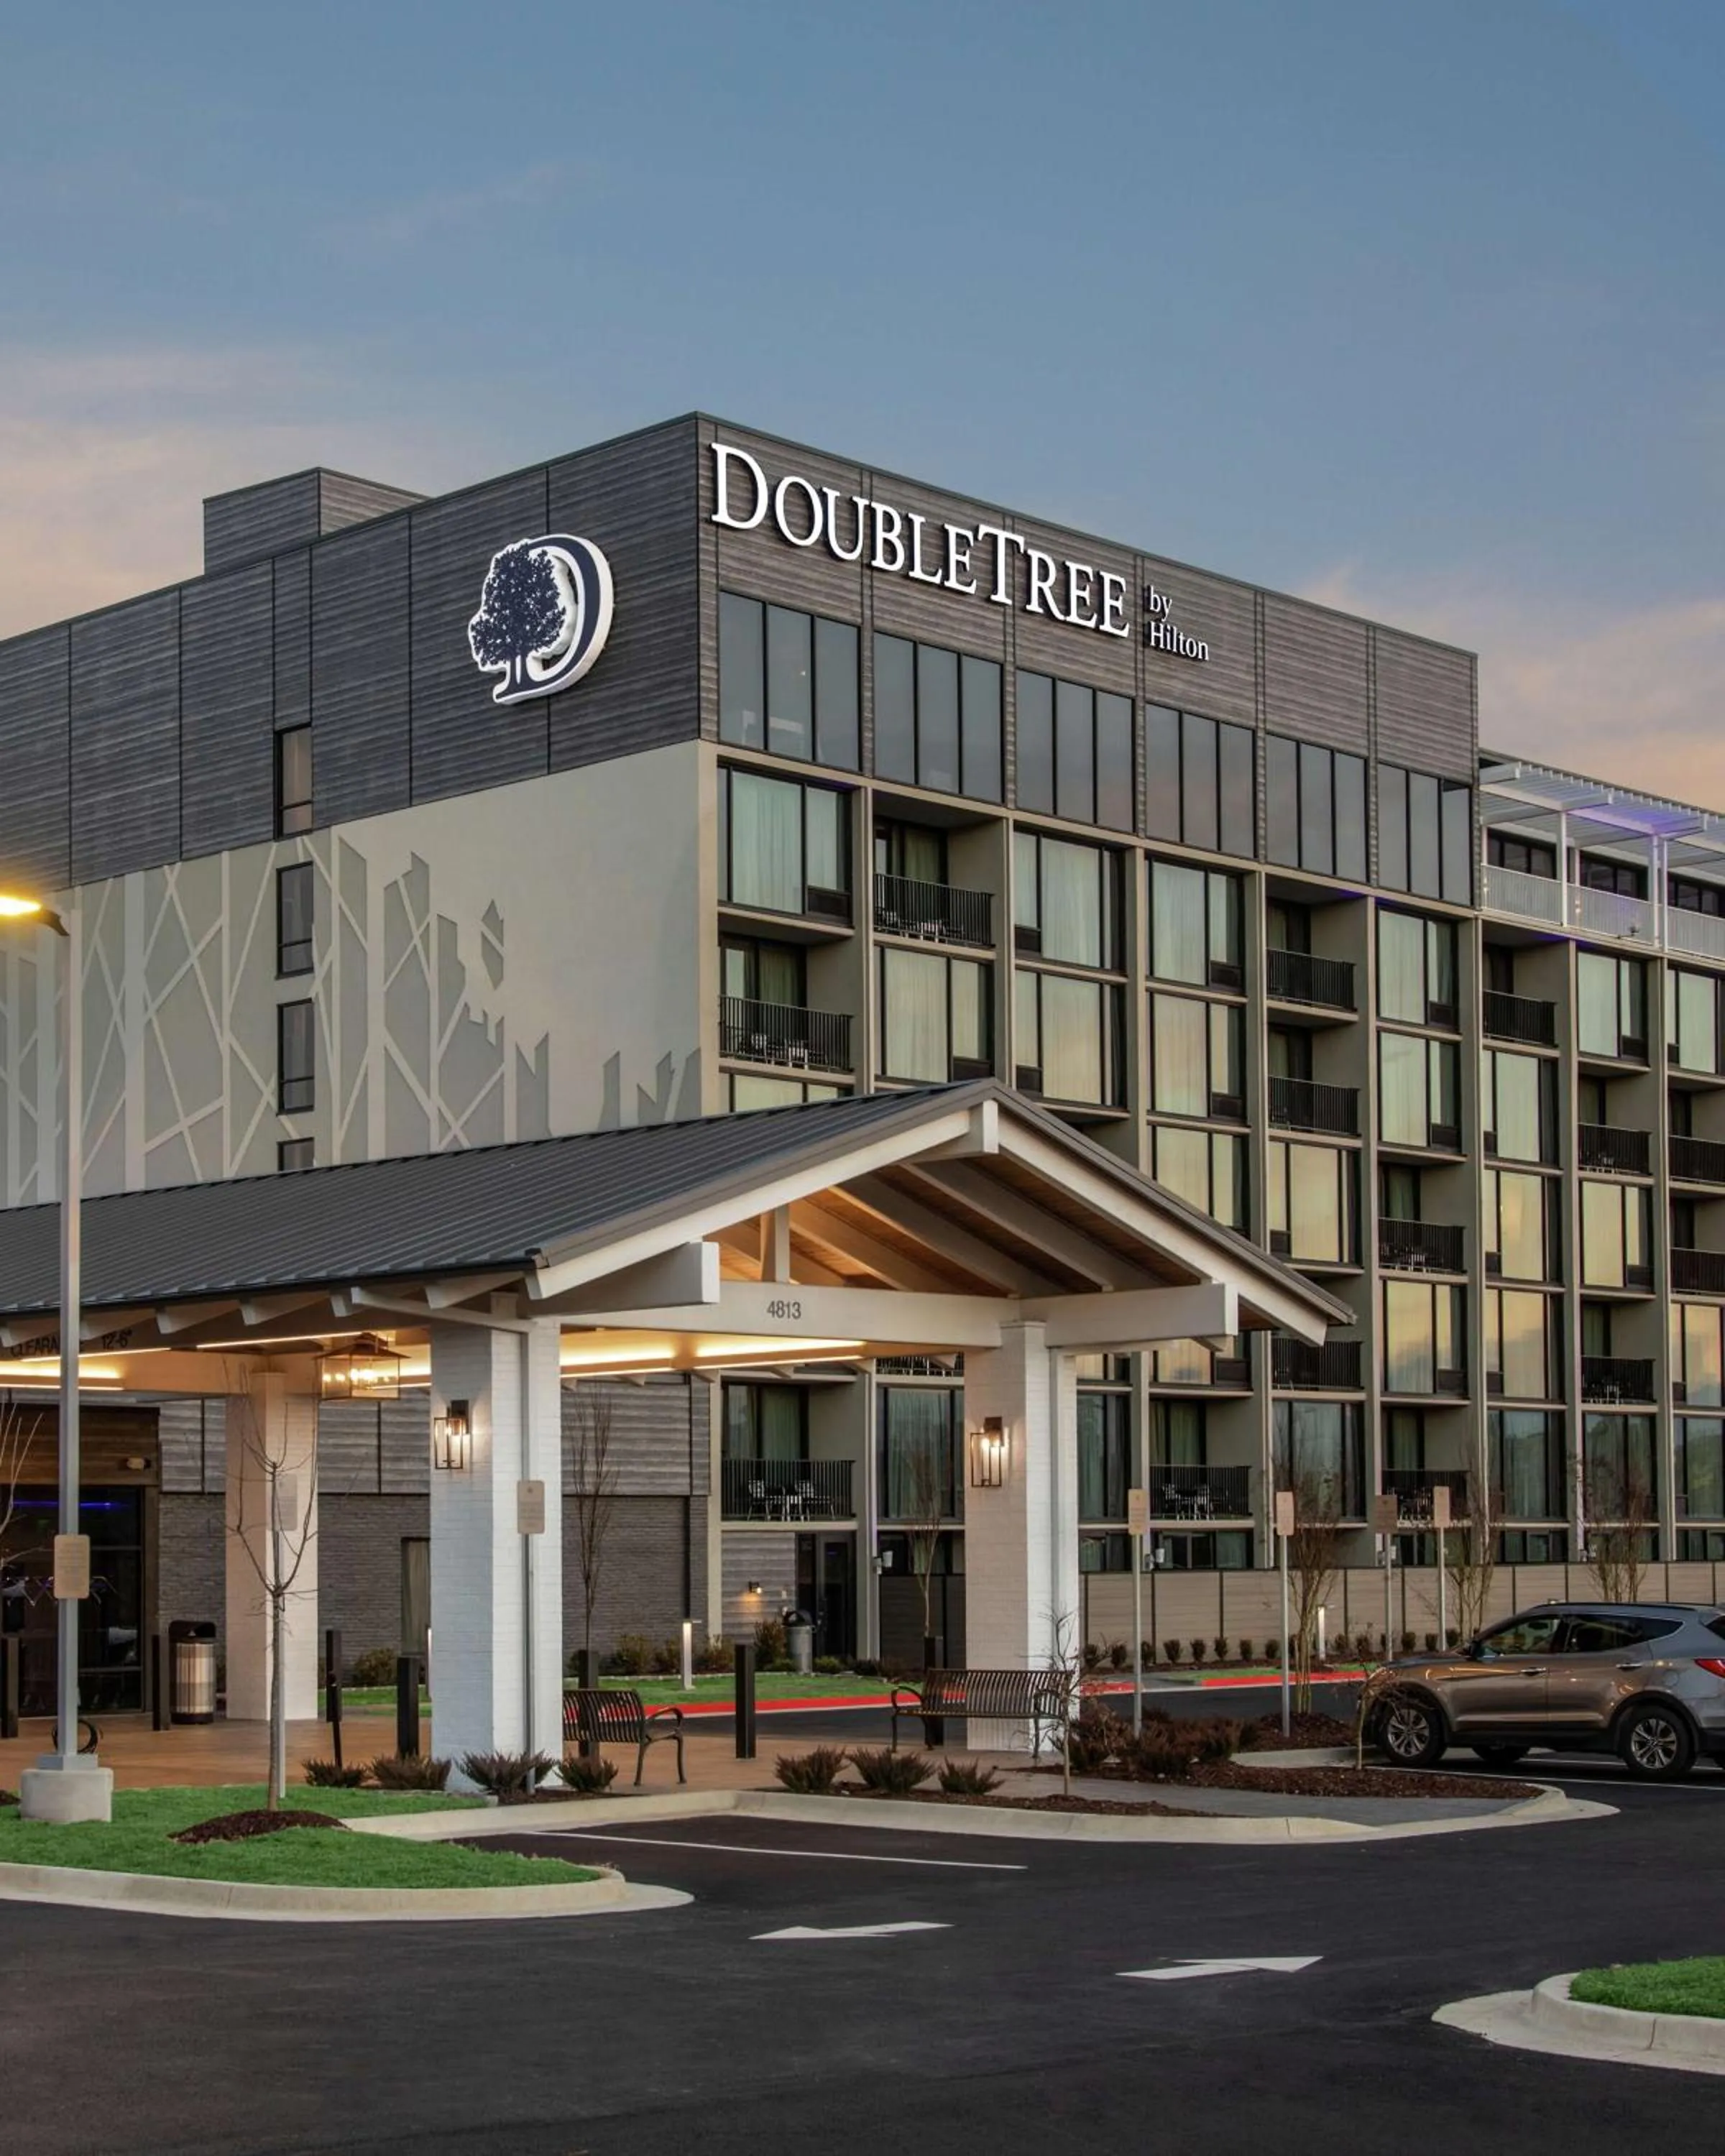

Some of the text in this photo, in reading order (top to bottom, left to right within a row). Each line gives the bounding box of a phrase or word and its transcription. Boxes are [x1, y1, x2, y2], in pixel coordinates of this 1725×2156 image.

[711, 442, 1130, 637] DOUBLETREE
[1150, 585, 1172, 622] by
[1150, 621, 1210, 660] Hilton
[767, 1300, 802, 1319] 4813
